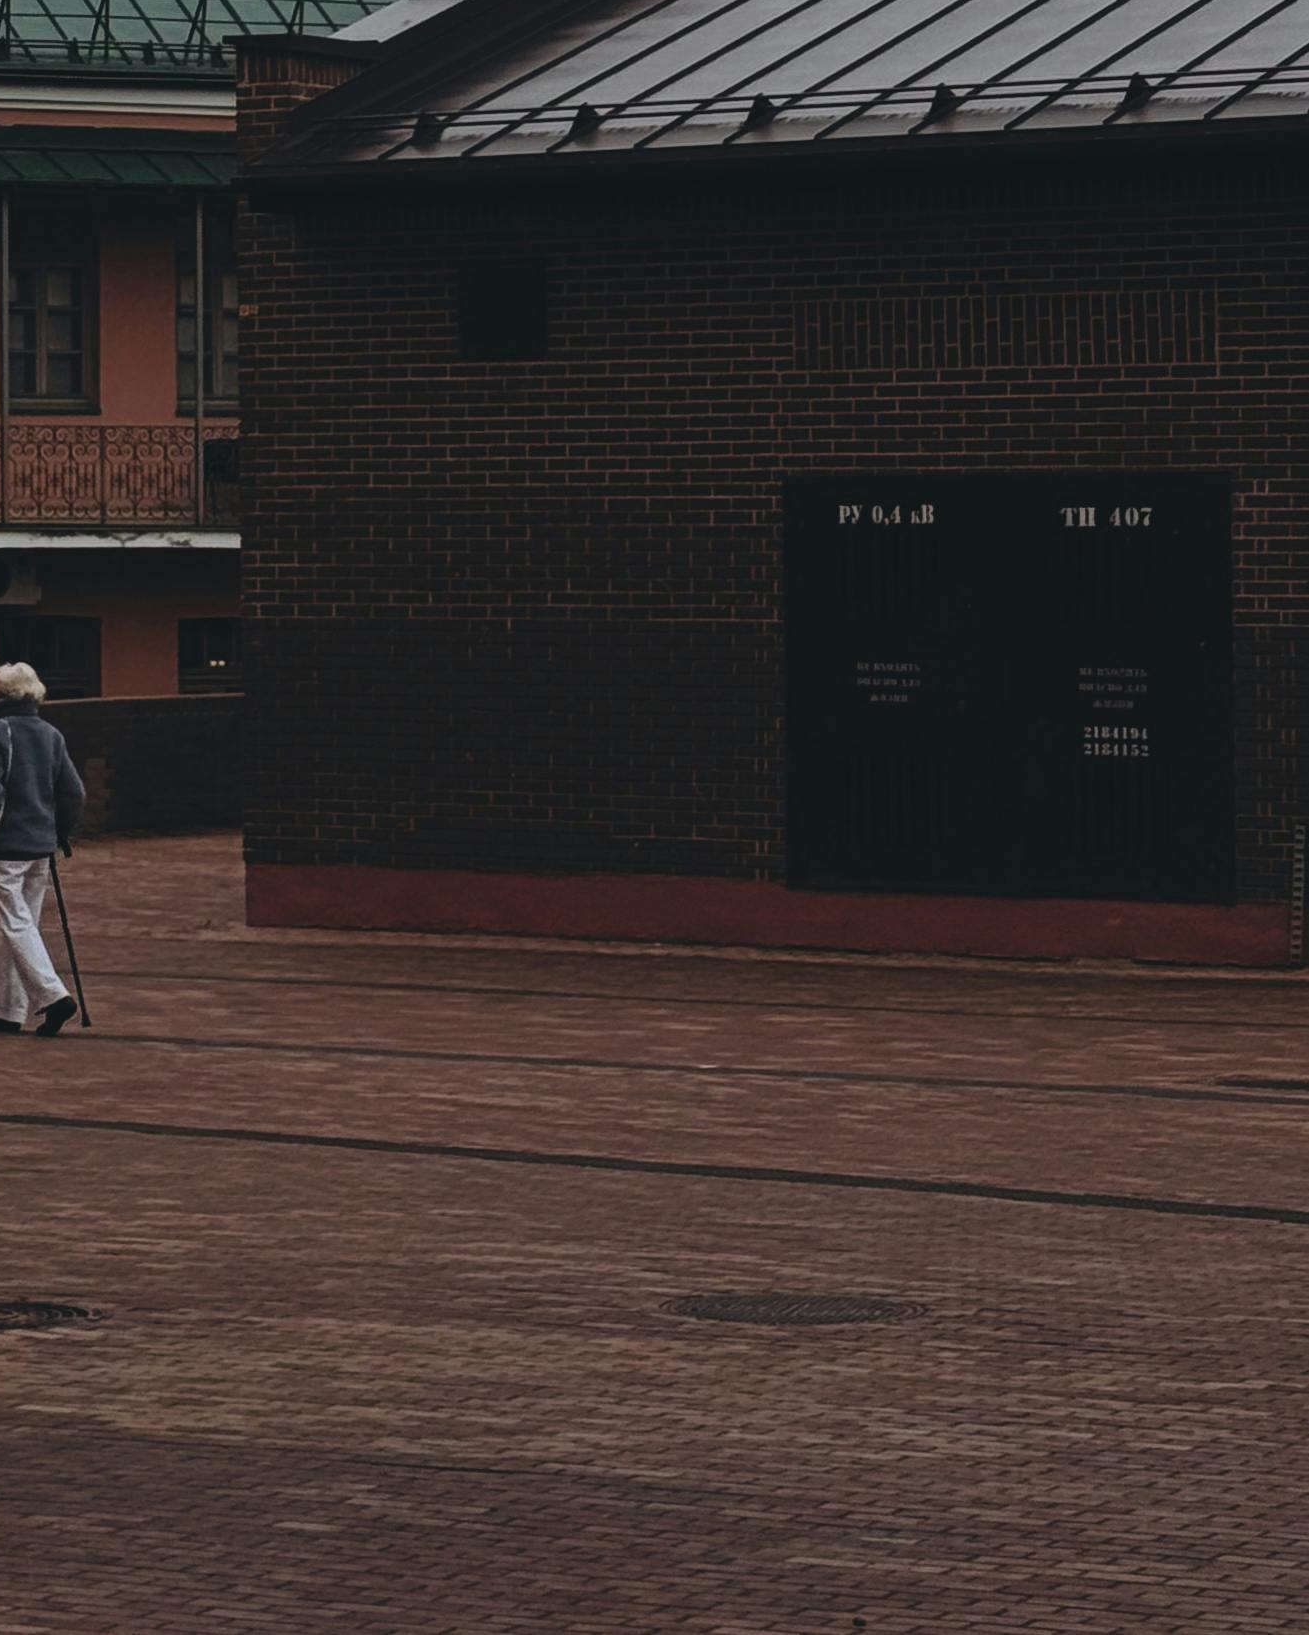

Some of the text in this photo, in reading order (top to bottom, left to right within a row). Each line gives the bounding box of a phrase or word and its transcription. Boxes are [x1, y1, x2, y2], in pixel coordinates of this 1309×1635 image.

[838, 504, 863, 525] РУ
[871, 504, 901, 526] 0,4
[1059, 507, 1152, 527] ТП 407
